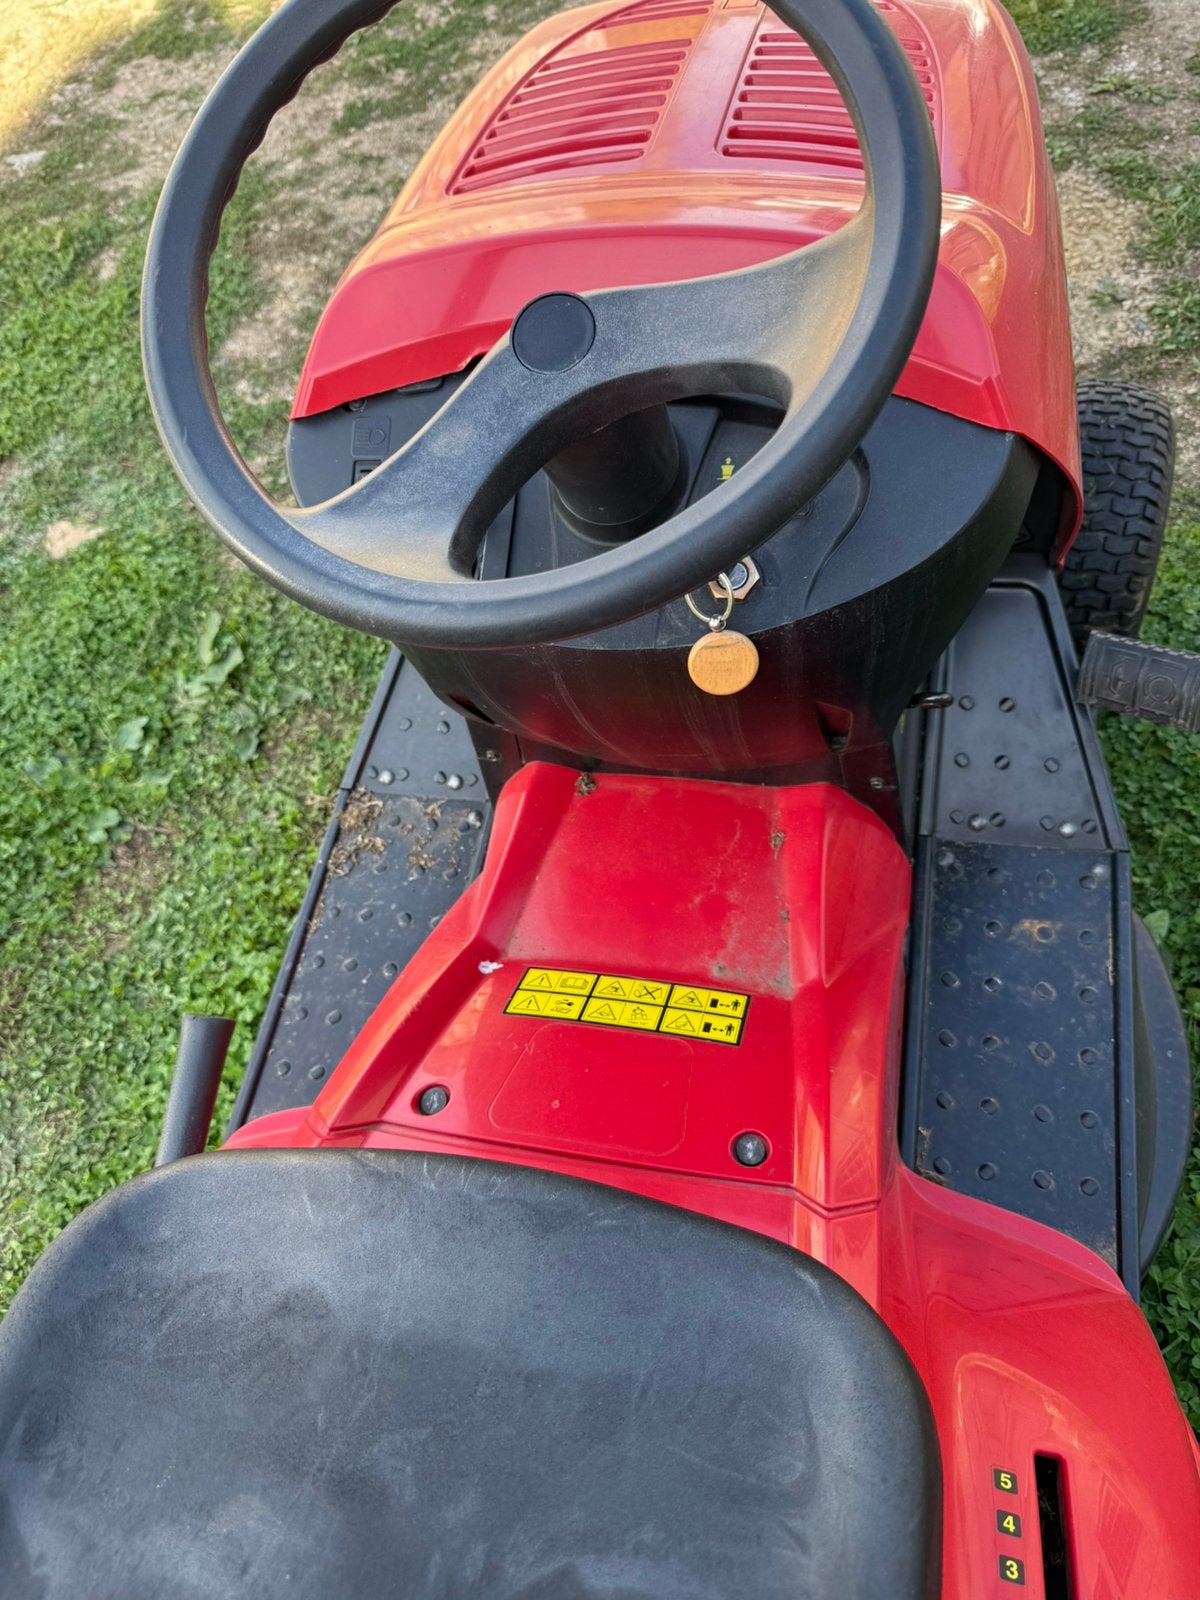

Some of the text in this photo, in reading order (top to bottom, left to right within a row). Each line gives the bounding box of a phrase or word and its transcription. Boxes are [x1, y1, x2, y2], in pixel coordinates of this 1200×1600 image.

[1000, 1472, 1012, 1490] 5
[1003, 1515, 1016, 1533] 4
[1006, 1560, 1019, 1580] 3
